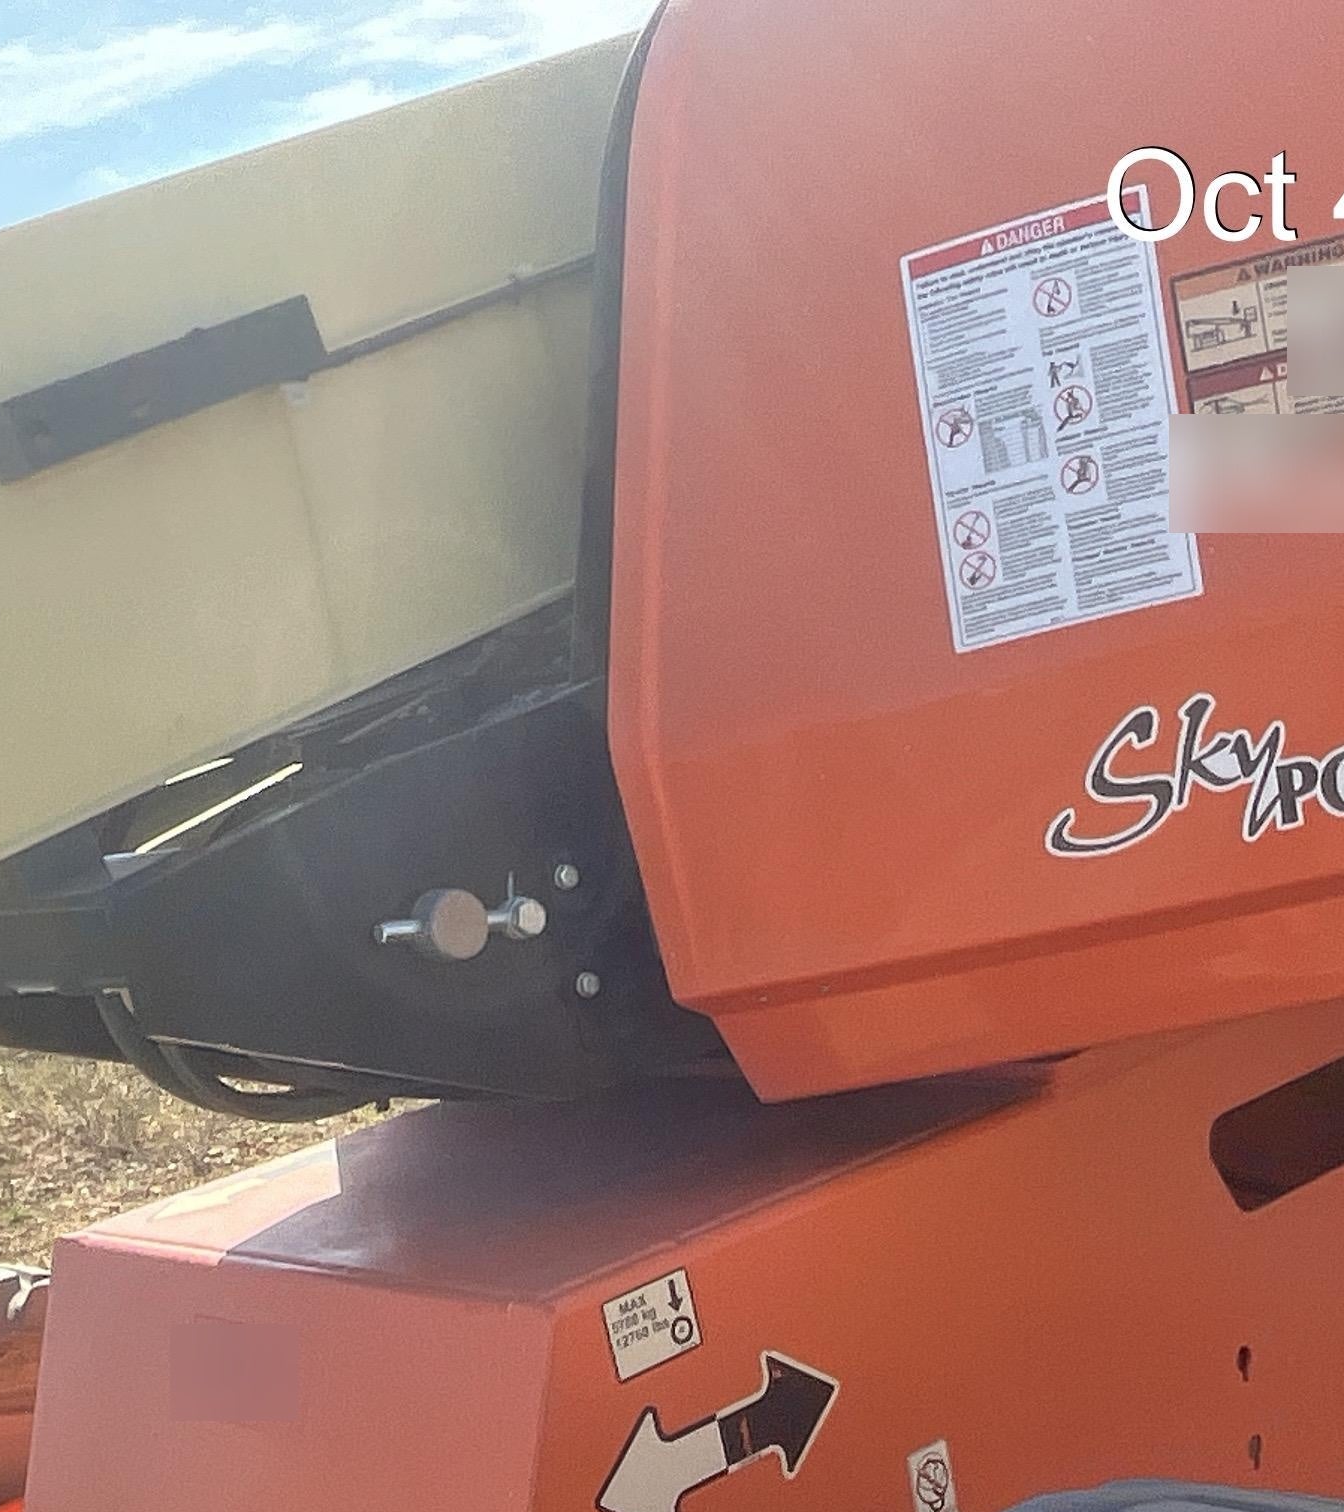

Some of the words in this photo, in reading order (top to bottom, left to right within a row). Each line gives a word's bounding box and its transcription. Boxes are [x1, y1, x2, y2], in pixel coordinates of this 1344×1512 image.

[997, 214, 1066, 251] DANGER
[1048, 695, 1282, 853] Sky
[619, 1294, 647, 1313] MAX
